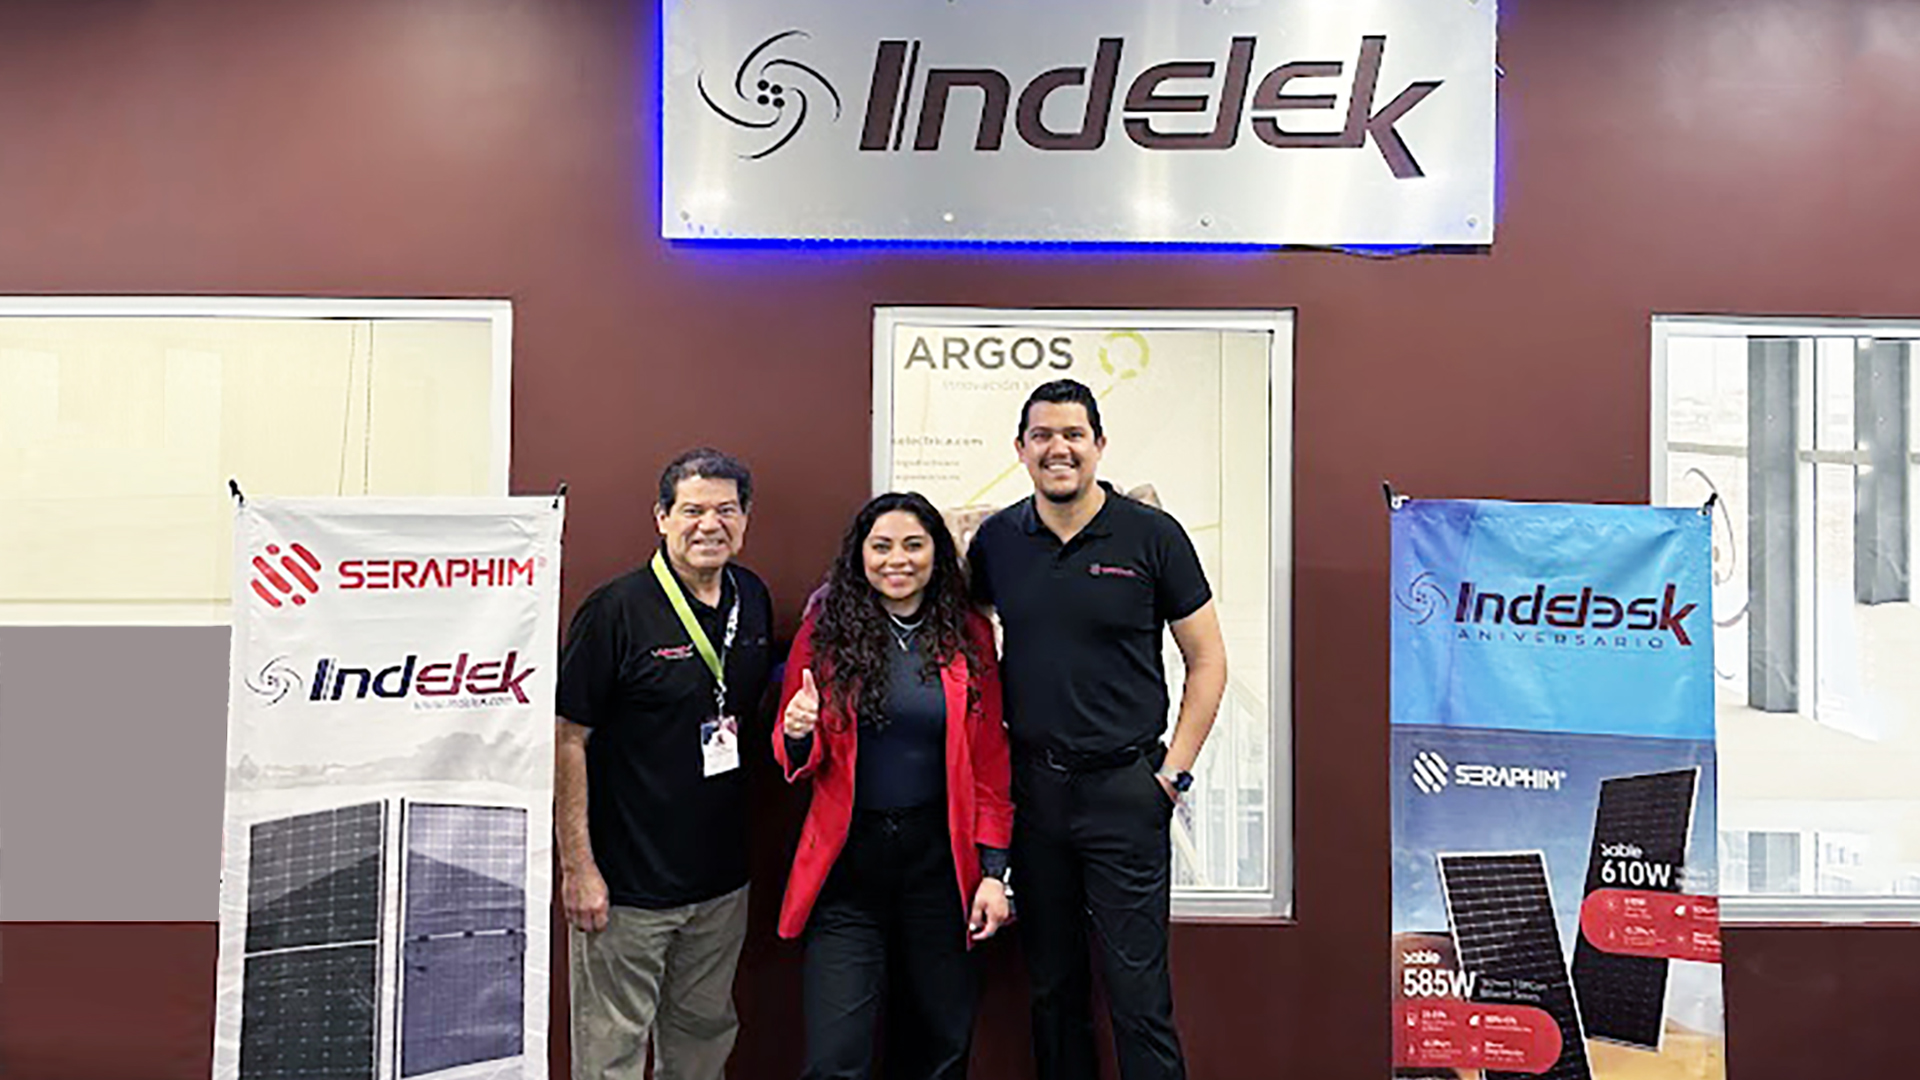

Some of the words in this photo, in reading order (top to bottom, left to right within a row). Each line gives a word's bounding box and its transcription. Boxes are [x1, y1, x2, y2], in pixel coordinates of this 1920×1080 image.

[859, 35, 1444, 179] Indelek
[904, 336, 1074, 371] ARGOS
[339, 557, 534, 589] SERAPHIM
[1457, 628, 1664, 650] ANIVERSARIO
[309, 651, 536, 704] Indelek
[1601, 858, 1671, 887] 610W
[1403, 968, 1477, 998] 585W
